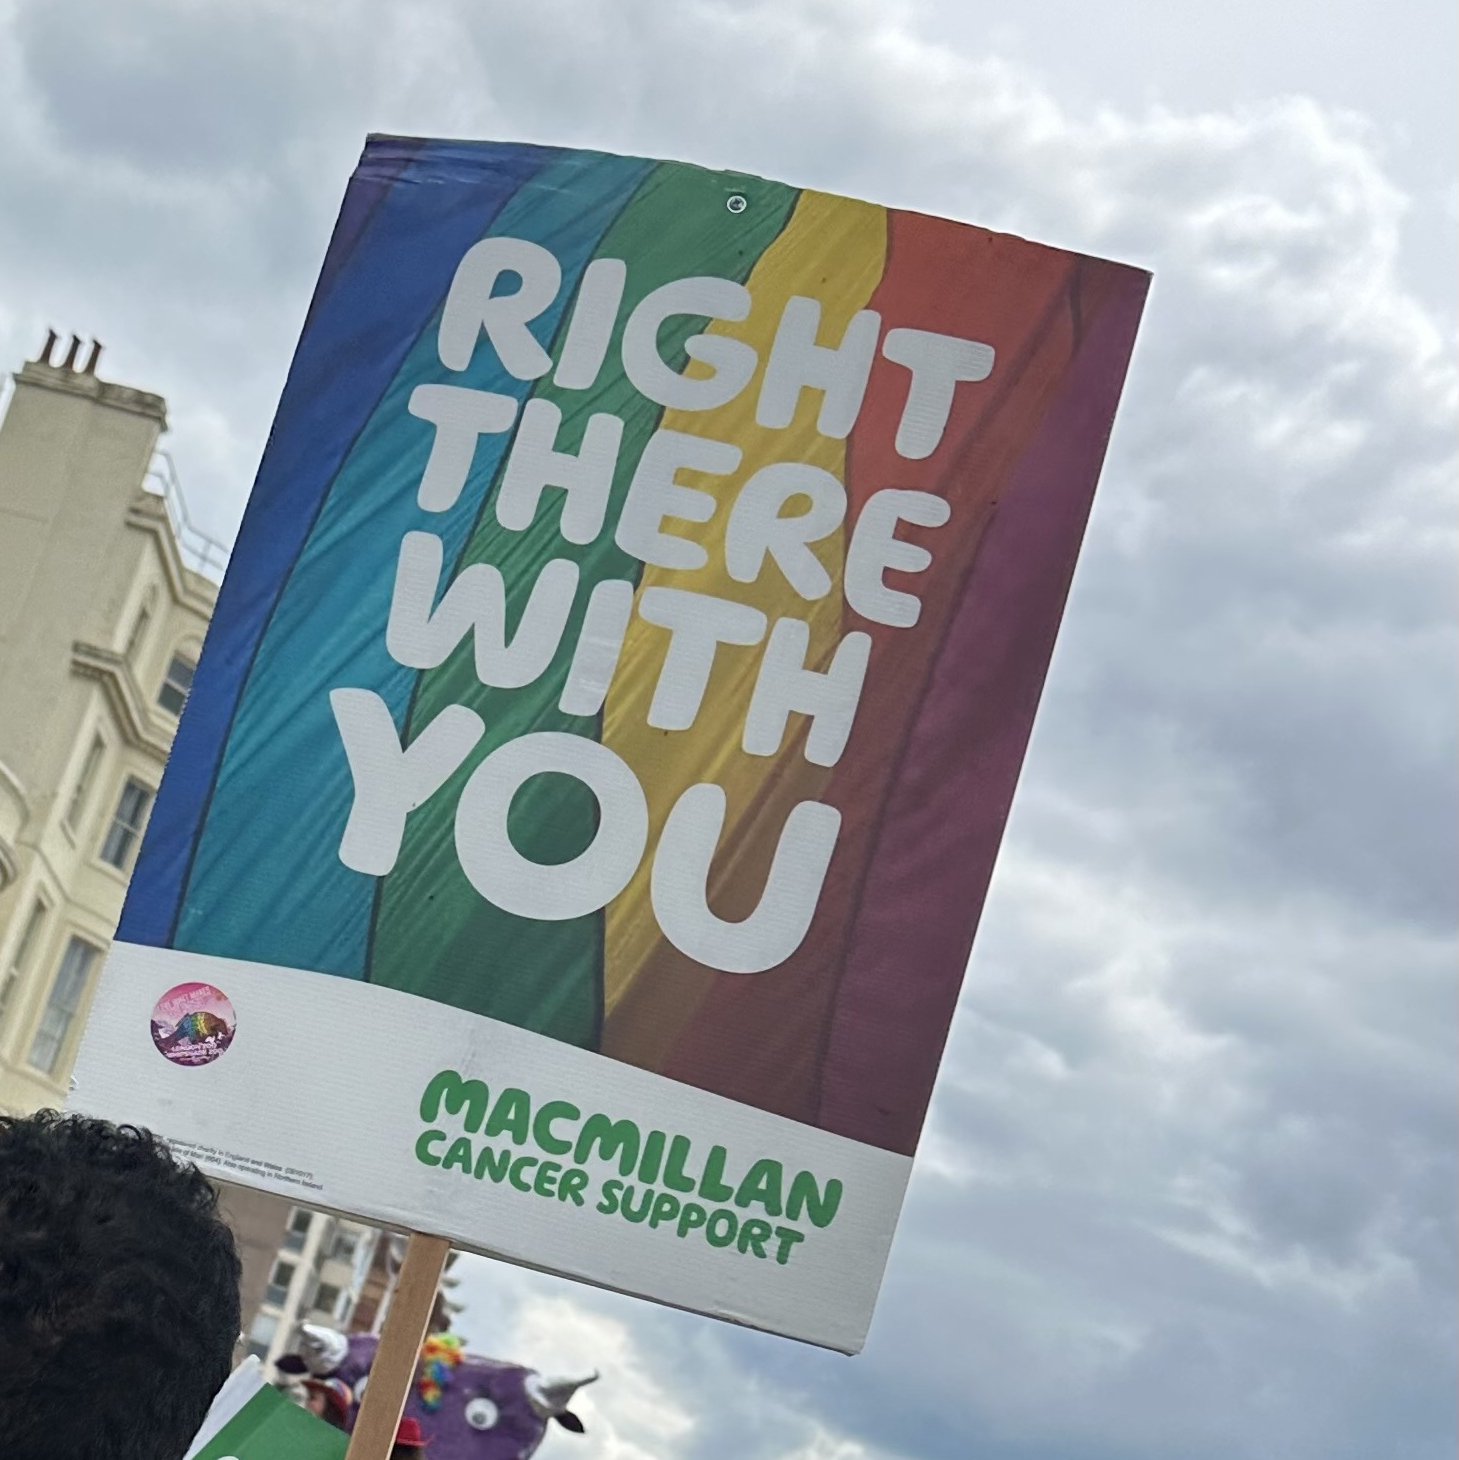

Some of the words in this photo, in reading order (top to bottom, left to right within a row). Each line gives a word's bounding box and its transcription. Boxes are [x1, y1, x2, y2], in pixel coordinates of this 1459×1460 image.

[436, 236, 996, 460] RIGHT
[407, 383, 952, 629] THERE
[386, 530, 872, 768] WITH
[328, 687, 842, 974] YOU
[225, 1151, 251, 1164] England
[251, 1159, 264, 1167] and
[414, 1129, 586, 1208] CANCER
[595, 1177, 805, 1265] SUPPORT
[419, 1068, 844, 1229] MACMILLAN
